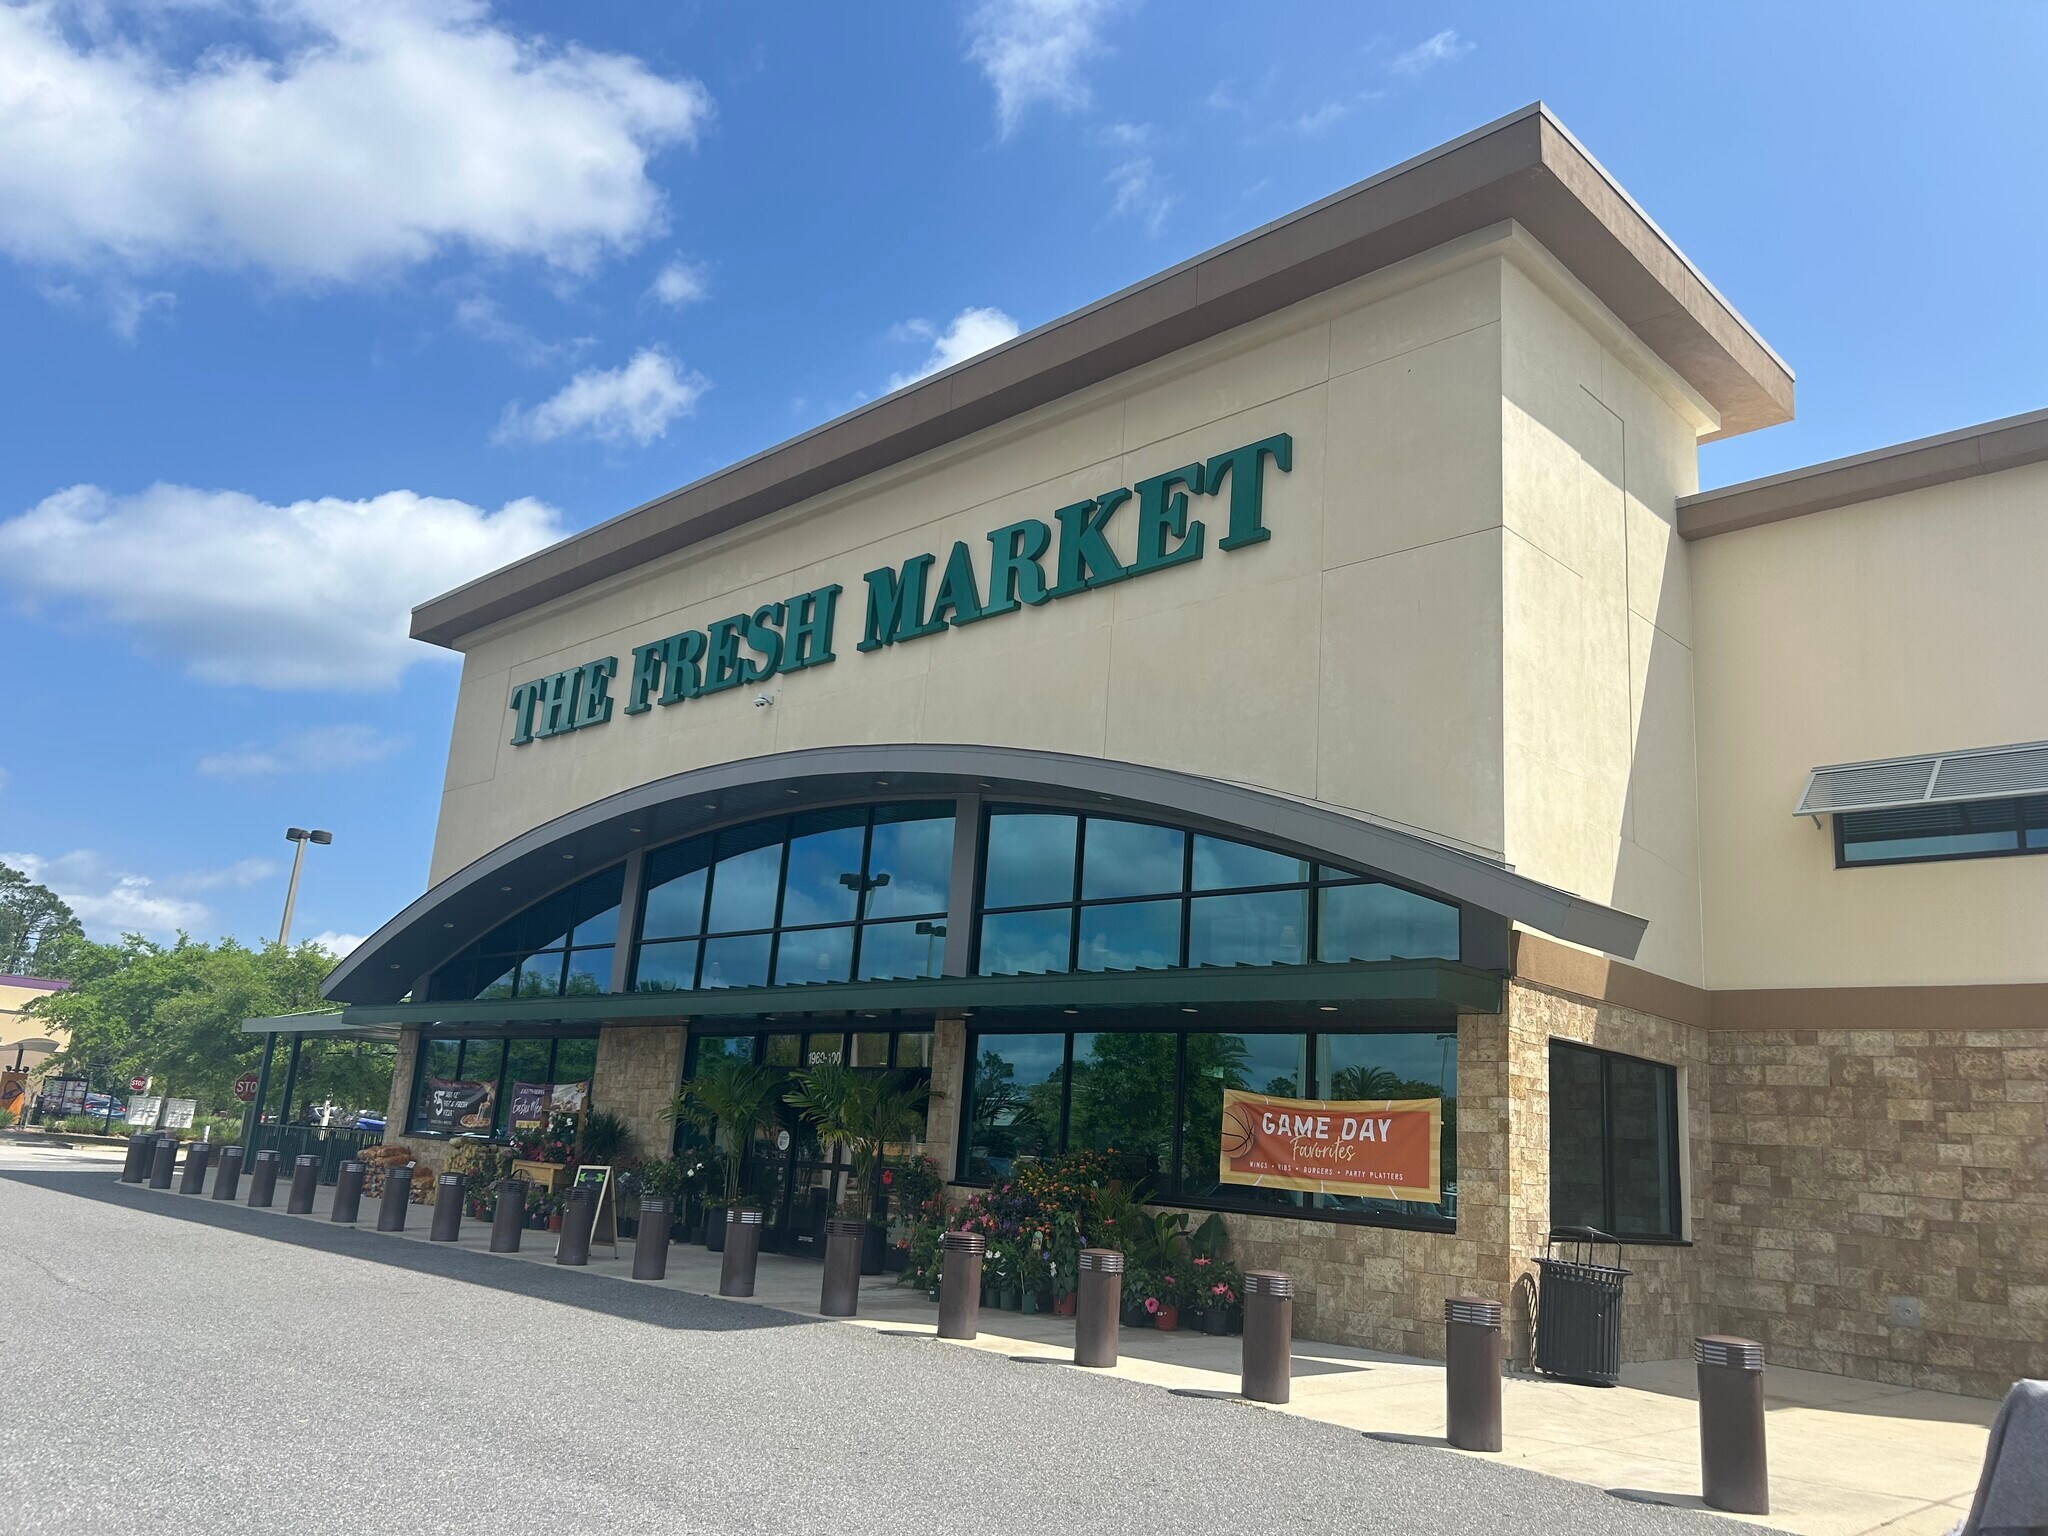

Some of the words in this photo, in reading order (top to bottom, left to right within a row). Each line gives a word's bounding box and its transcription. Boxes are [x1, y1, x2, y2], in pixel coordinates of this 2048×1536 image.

[510, 656, 617, 746] THE
[624, 583, 842, 716] FRESH
[856, 432, 1293, 653] MARKET
[132, 1079, 145, 1088] STOP
[236, 1081, 258, 1093] STO
[1262, 1112, 1331, 1140] GAME
[1341, 1117, 1392, 1143] DAY
[1289, 1135, 1356, 1163] Favorites
[1249, 1160, 1268, 1169] WINGS
[1277, 1163, 1292, 1172] RIBS
[1303, 1166, 1333, 1176] BURGERS
[1345, 1169, 1366, 1178] PARTY
[1369, 1172, 1404, 1181] PLATTERS
